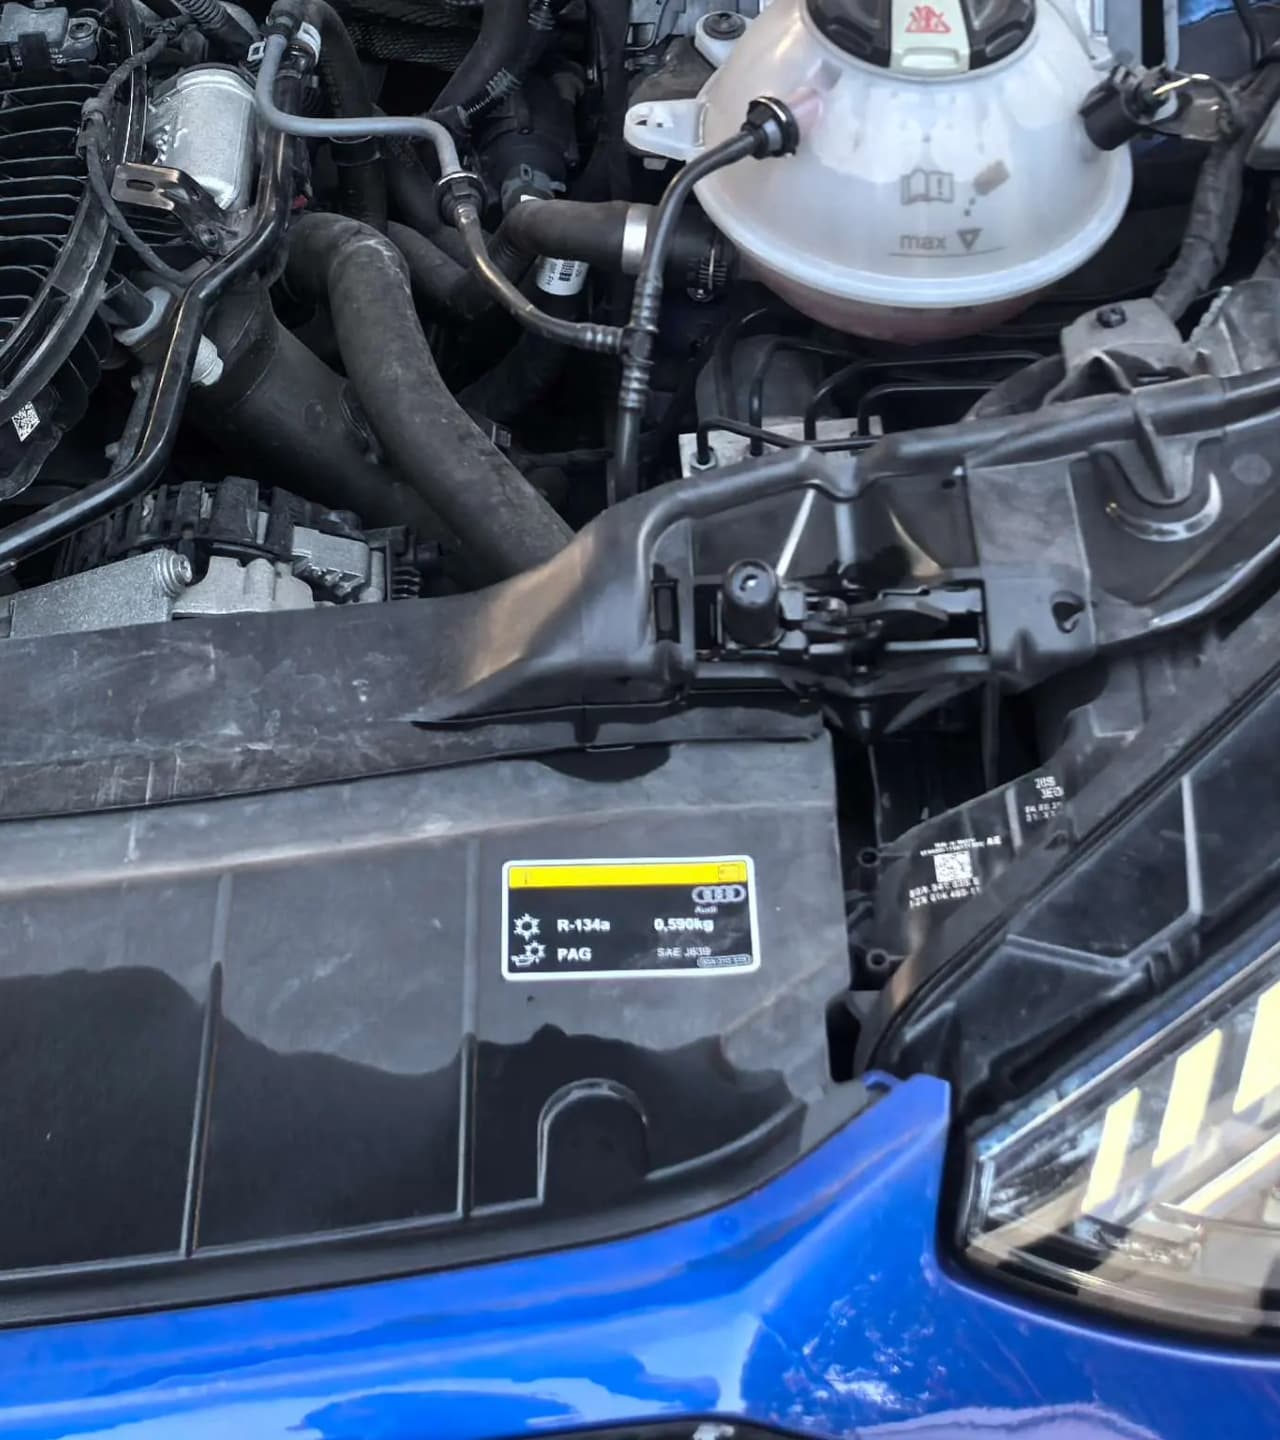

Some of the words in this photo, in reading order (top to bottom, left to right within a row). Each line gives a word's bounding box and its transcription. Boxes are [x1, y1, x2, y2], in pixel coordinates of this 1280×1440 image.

[899, 233, 948, 250] max
[694, 906, 718, 914] Audi
[556, 918, 611, 932] R-134a
[556, 947, 593, 961] PAG
[656, 947, 682, 957] SAE
